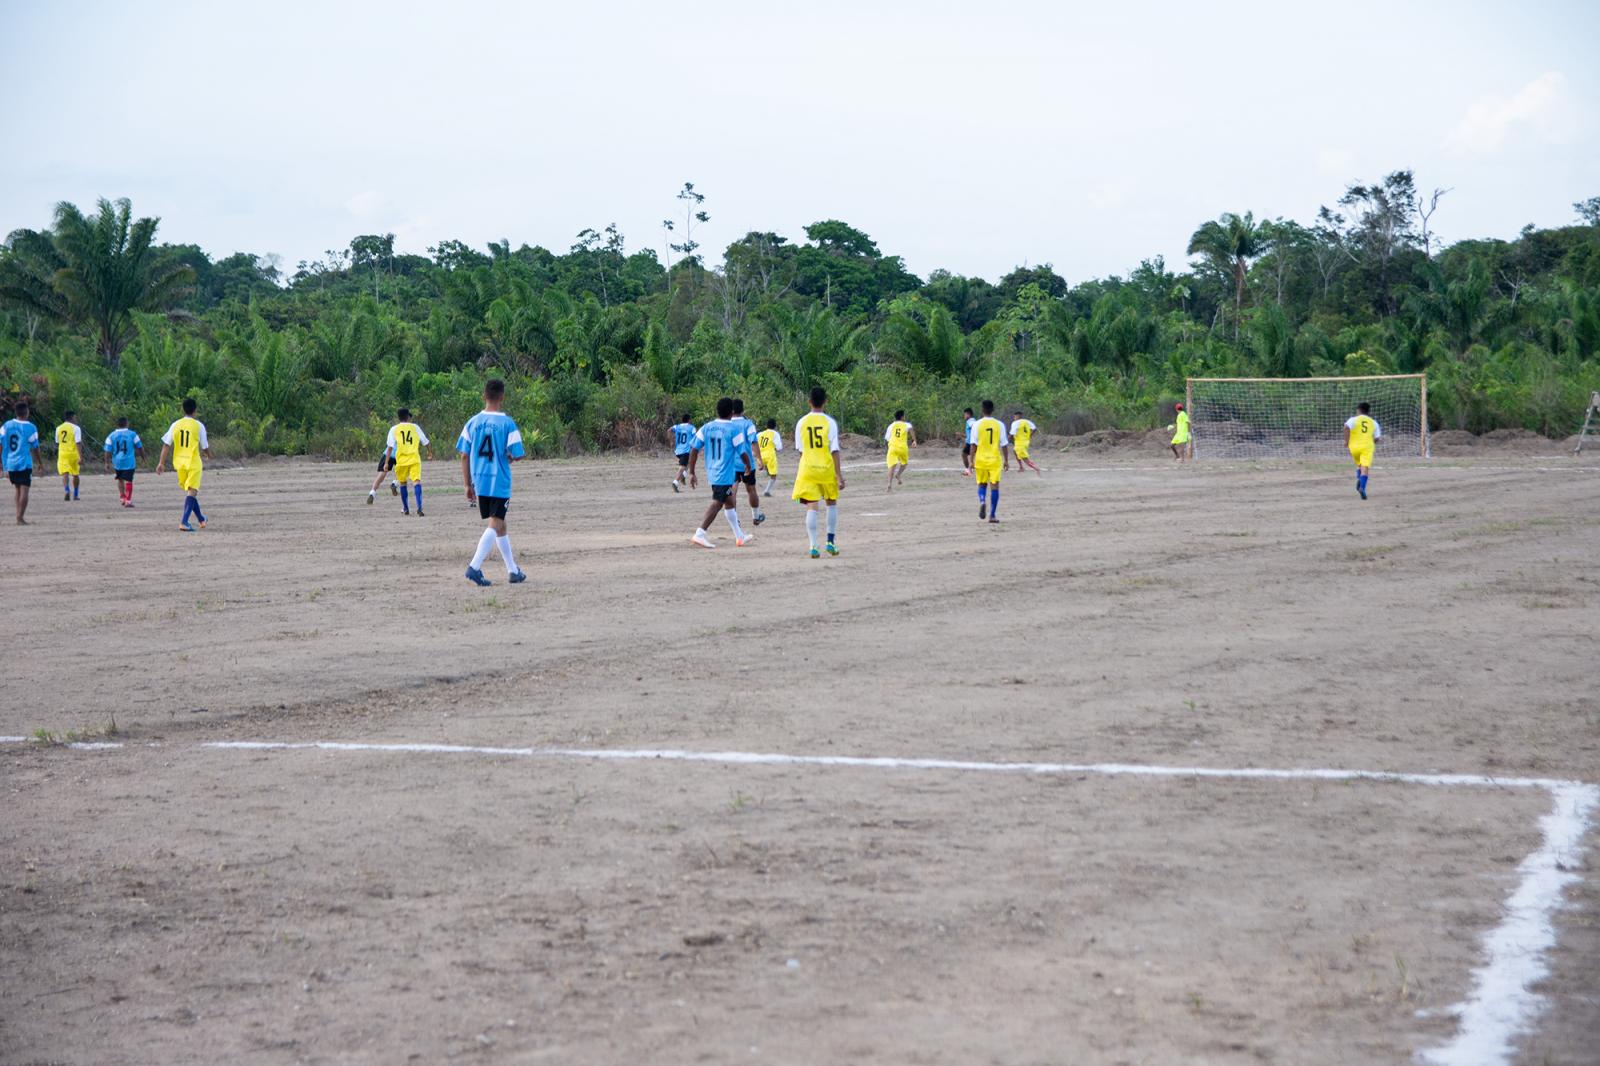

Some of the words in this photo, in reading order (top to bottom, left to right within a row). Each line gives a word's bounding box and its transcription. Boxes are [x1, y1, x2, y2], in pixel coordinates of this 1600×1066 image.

[1361, 421, 1368, 432] 5
[9, 434, 18, 452] 6
[62, 430, 68, 444] 2
[180, 430, 190, 448] 11
[400, 430, 413, 445] 14
[678, 432, 687, 444] 10
[806, 427, 824, 448] 15
[986, 428, 993, 444] 7
[116, 440, 128, 454] 14
[479, 435, 494, 462] 4
[710, 438, 722, 460] 11
